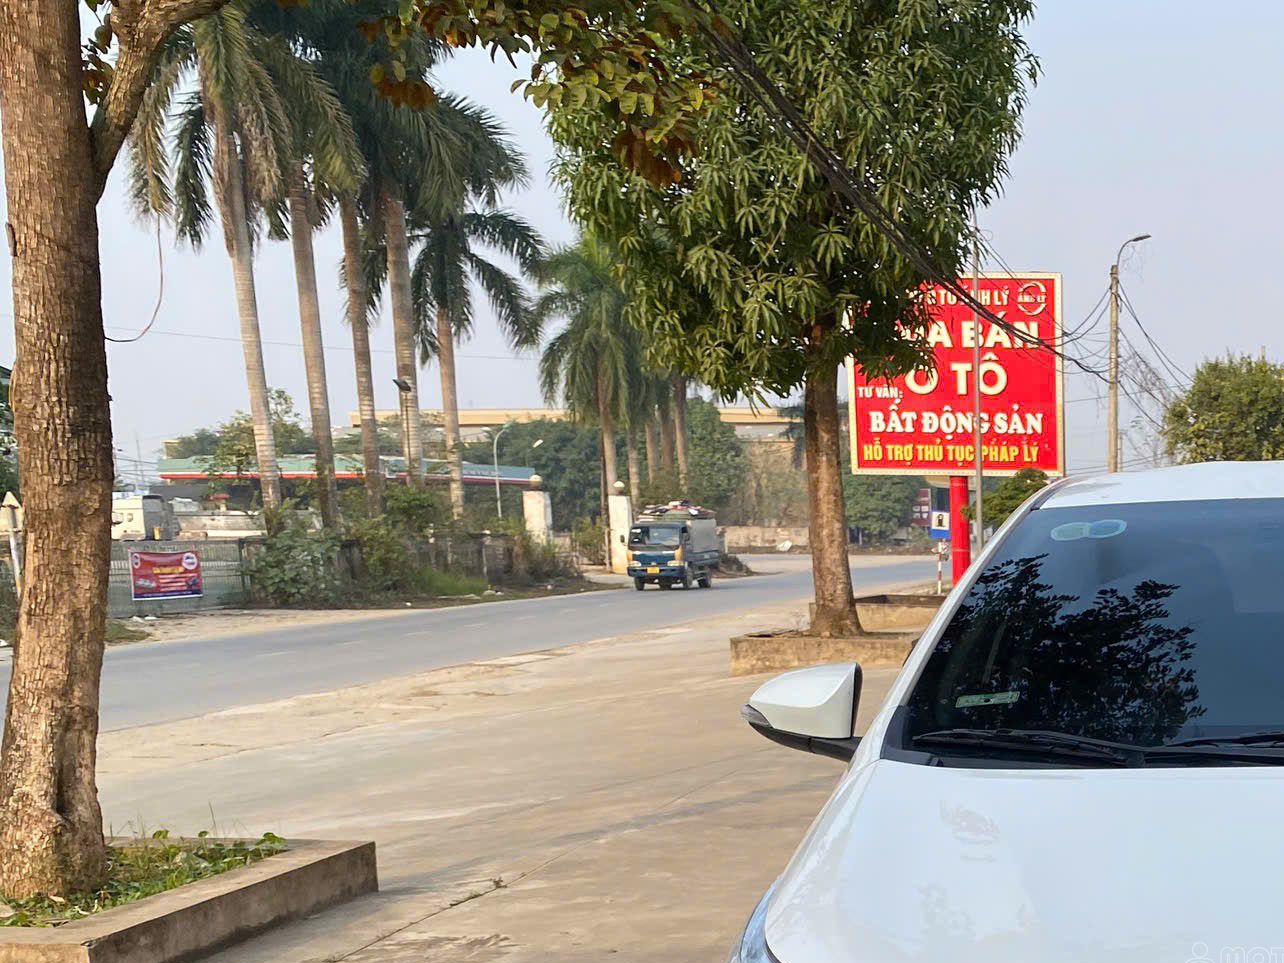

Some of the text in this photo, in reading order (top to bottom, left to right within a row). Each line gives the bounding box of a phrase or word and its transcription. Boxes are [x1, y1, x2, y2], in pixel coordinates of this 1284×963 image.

[961, 311, 1039, 349] BÁN
[951, 352, 1008, 396] TÔ
[869, 398, 1043, 440] BẤT ĐỘNG SẢN
[864, 437, 883, 461] HỖ
[886, 443, 913, 466] TRỢ
[916, 437, 944, 462] THỦ
[946, 444, 976, 466] TỤC
